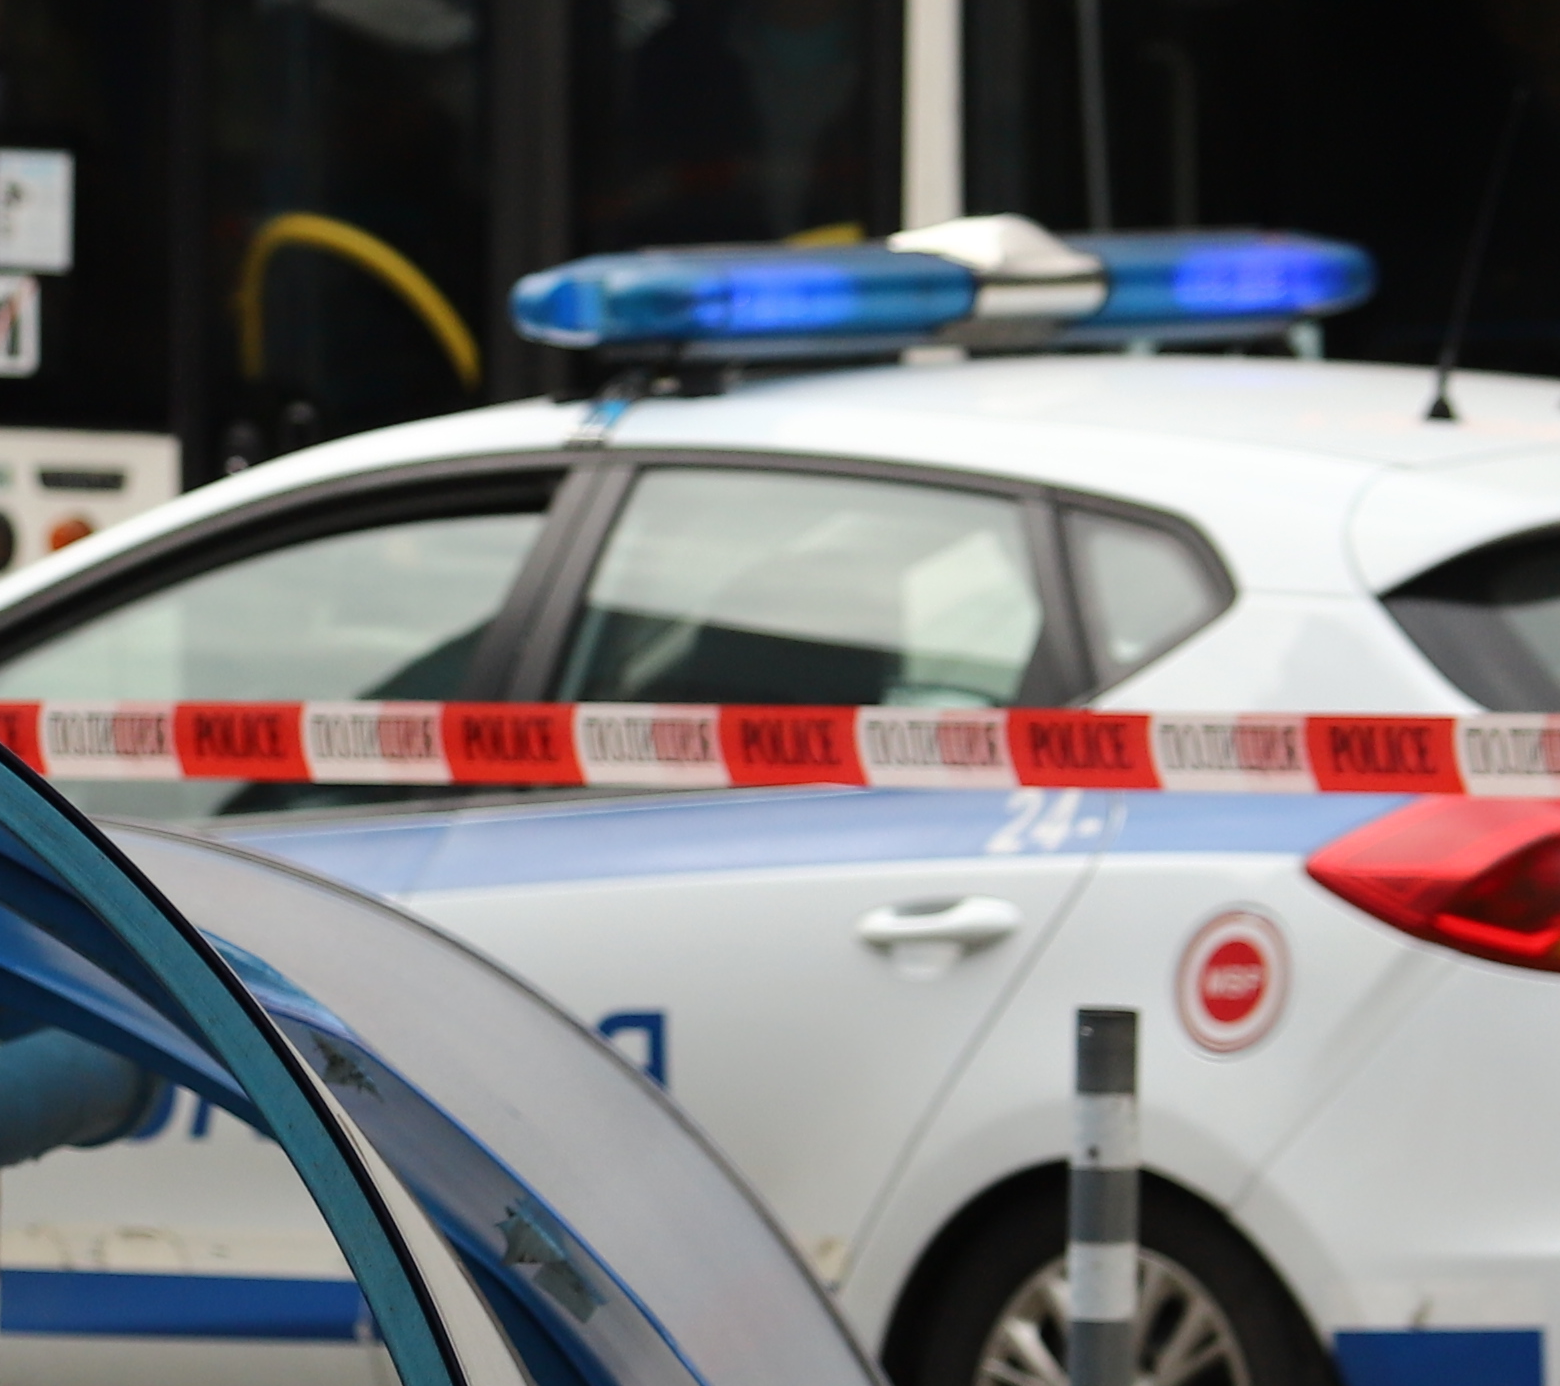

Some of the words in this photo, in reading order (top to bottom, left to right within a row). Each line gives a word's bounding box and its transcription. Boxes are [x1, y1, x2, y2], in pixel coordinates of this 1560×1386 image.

[462, 716, 558, 762] POLICE
[739, 718, 843, 766] POLICE
[1027, 721, 1132, 770] POLICE
[1329, 724, 1438, 775] POLICE
